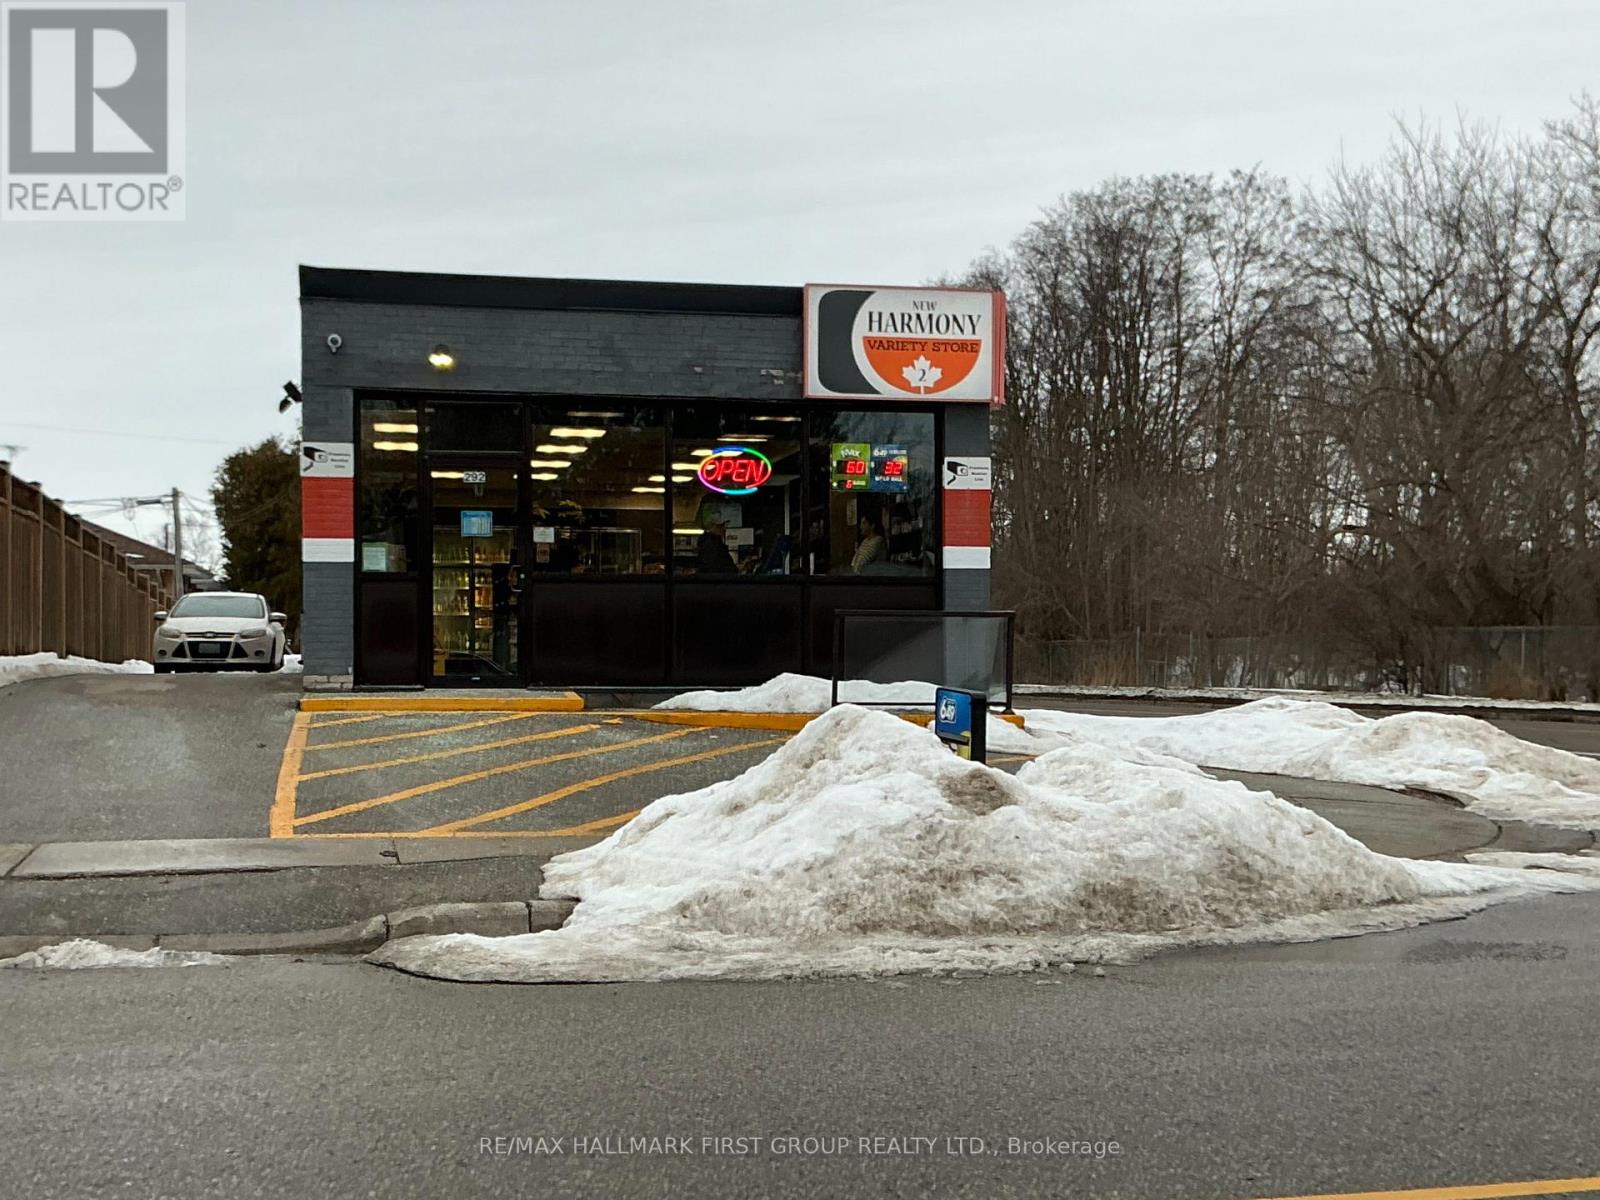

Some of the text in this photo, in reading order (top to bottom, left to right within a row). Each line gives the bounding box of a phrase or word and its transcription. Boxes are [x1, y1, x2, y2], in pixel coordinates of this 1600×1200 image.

[912, 300, 938, 311] NEW
[867, 311, 982, 336] HARMONY
[867, 340, 979, 353] VARIETY STORE
[918, 368, 927, 382] 2
[703, 459, 765, 482] OPEN
[846, 461, 865, 474] 60
[884, 461, 903, 475] 32
[464, 472, 486, 482] 292
